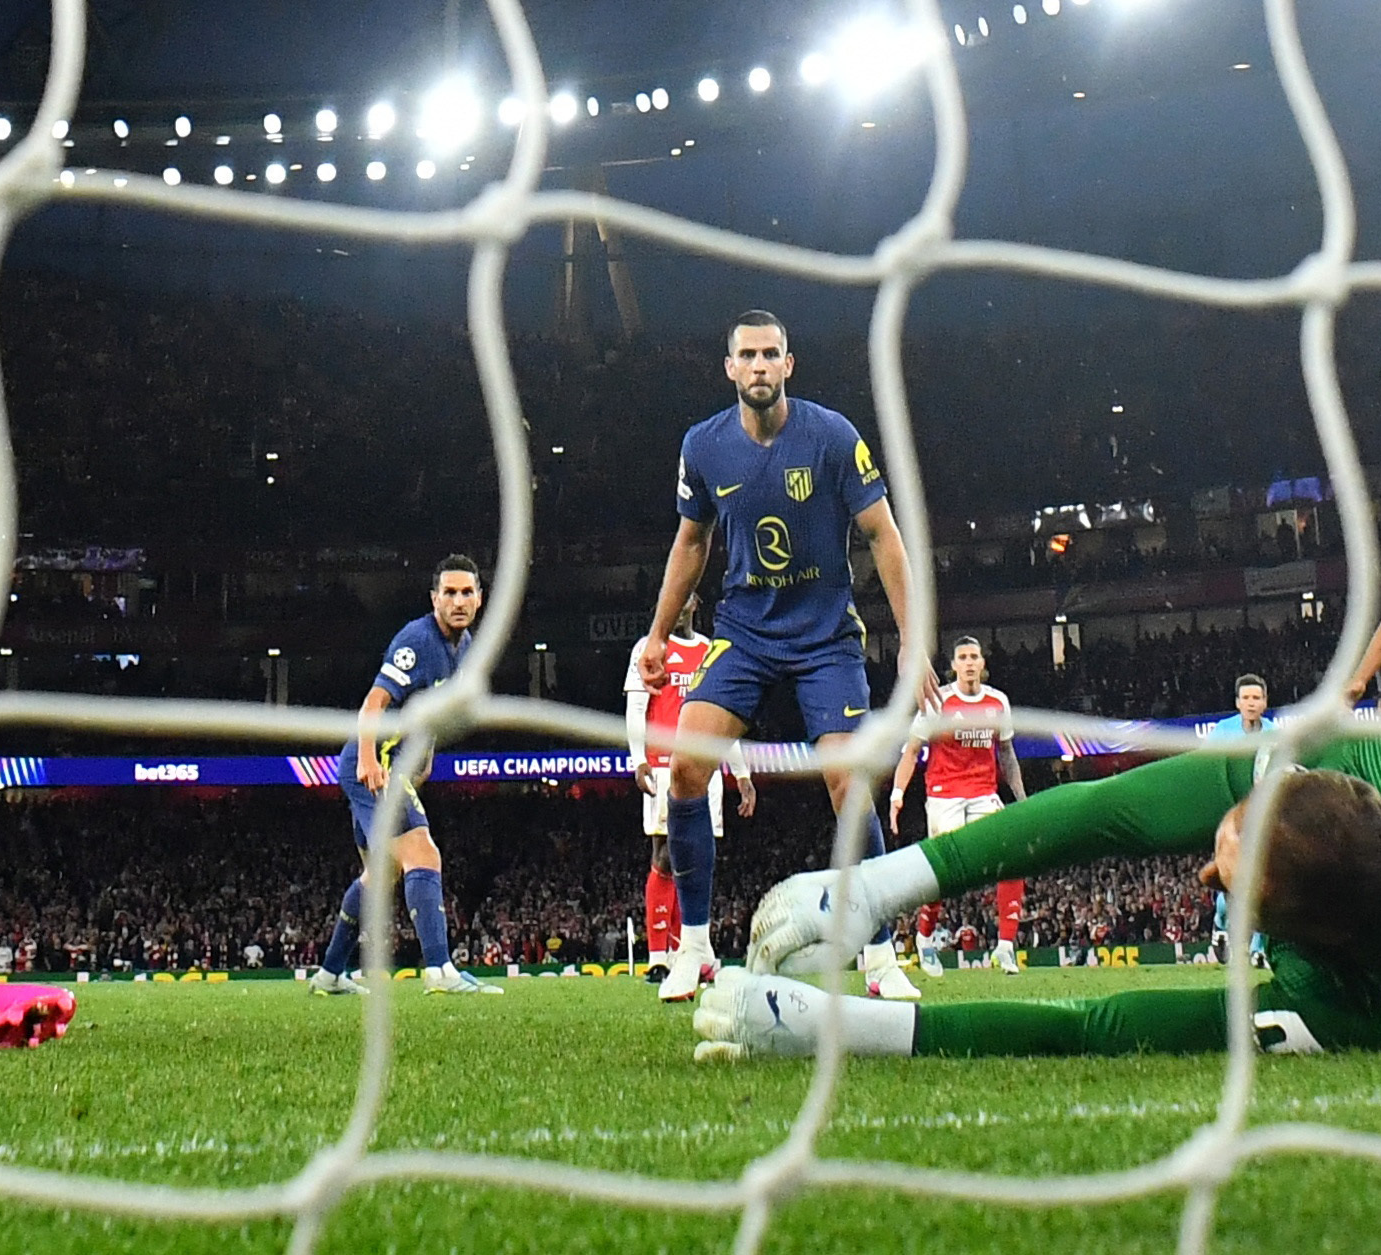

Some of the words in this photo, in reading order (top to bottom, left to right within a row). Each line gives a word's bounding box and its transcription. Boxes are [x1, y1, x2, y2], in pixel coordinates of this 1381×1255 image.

[746, 571, 794, 589] RIYADH
[797, 566, 821, 583] AIR
[134, 763, 200, 782] bet365
[453, 759, 500, 777] UEFA
[503, 755, 613, 775] CHAMPIONS
